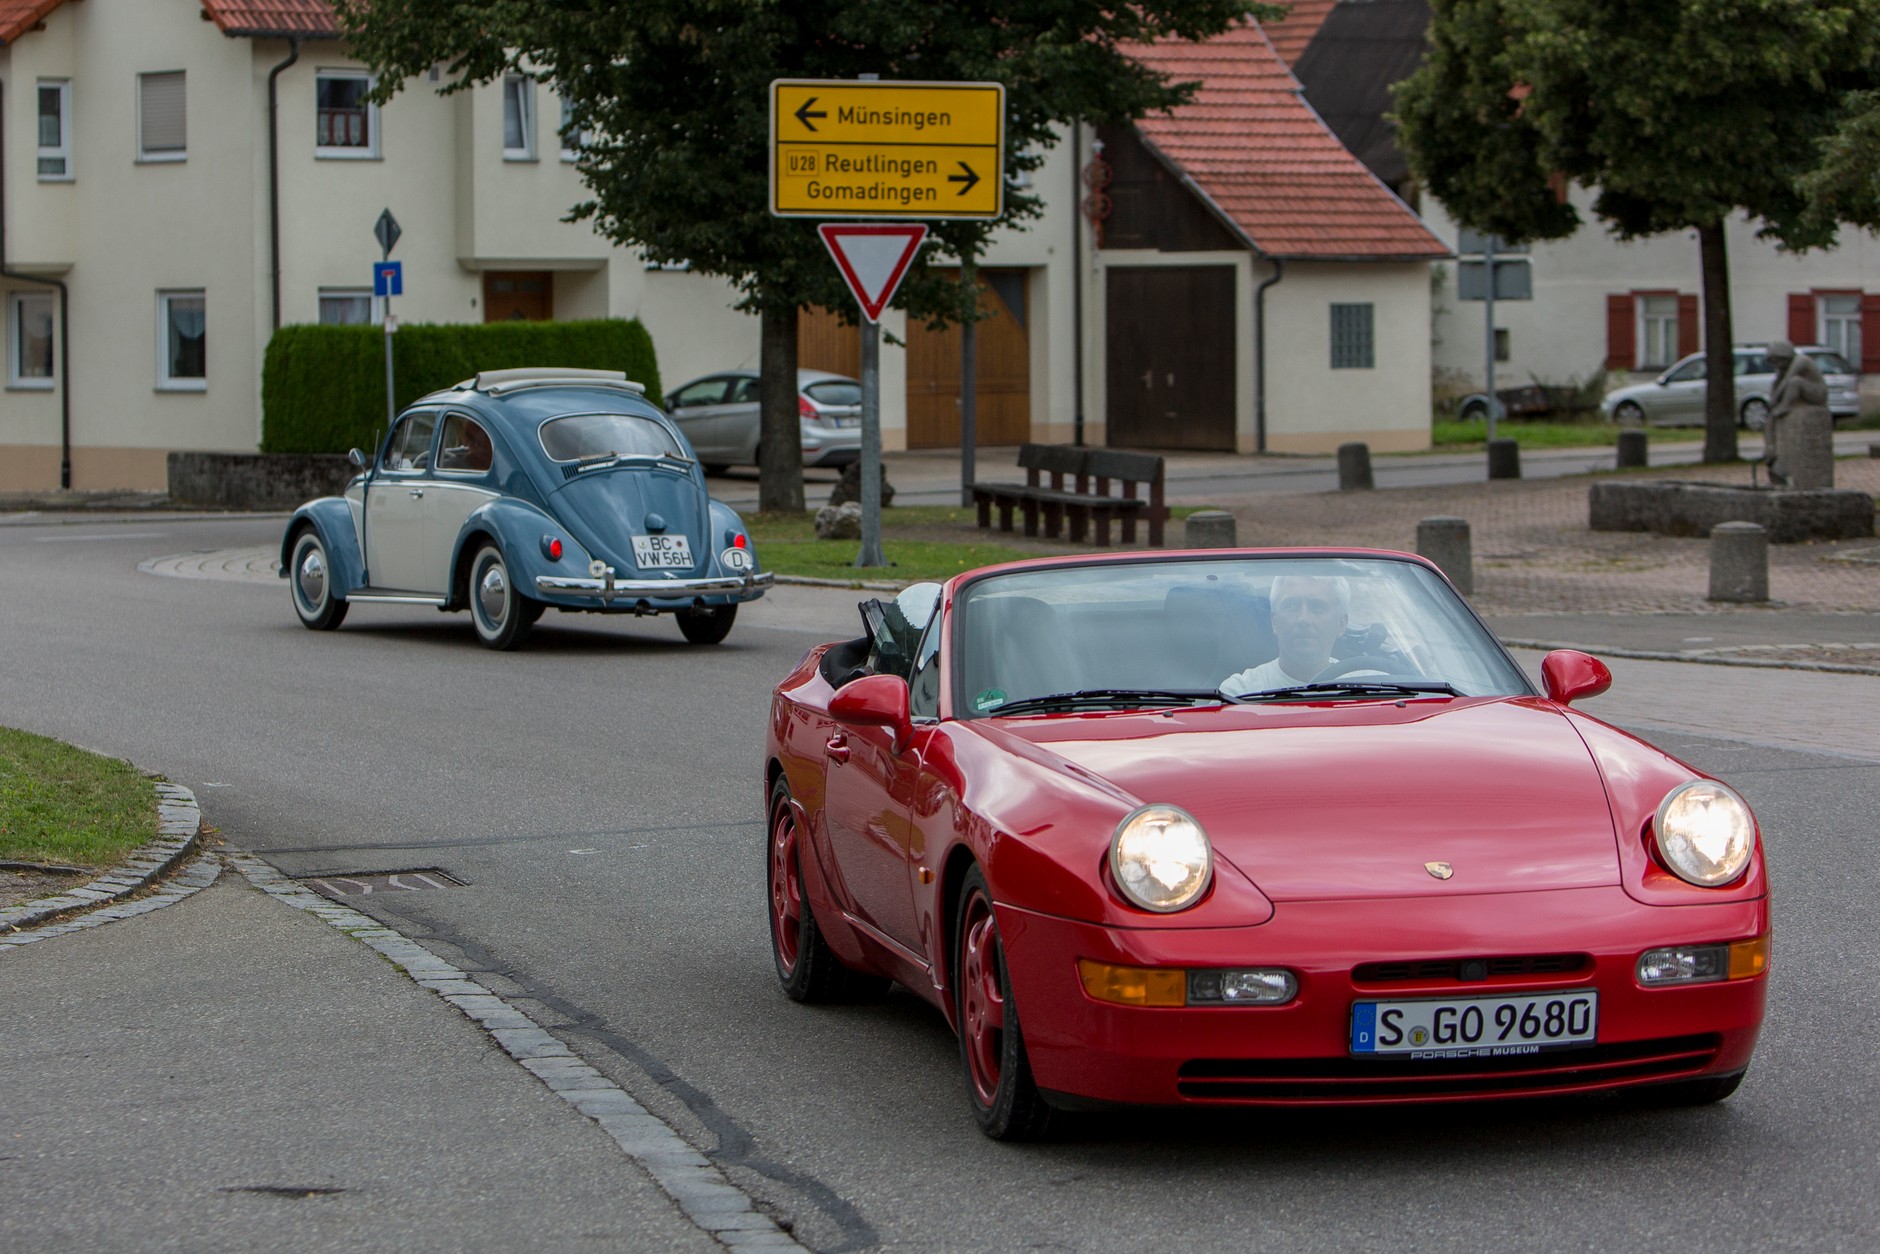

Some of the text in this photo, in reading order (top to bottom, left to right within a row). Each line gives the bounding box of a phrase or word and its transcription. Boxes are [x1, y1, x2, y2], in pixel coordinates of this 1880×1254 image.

[838, 106, 951, 130] Münsingen
[825, 154, 937, 177] Reutlingen
[807, 181, 937, 205] Gomadingen
[650, 537, 672, 551] BC
[637, 551, 693, 566] VW 56H
[732, 552, 743, 567] D
[1359, 998, 1591, 1046] D S GO 9680
[1411, 1045, 1539, 1060] PORSCHE MUSEUM
